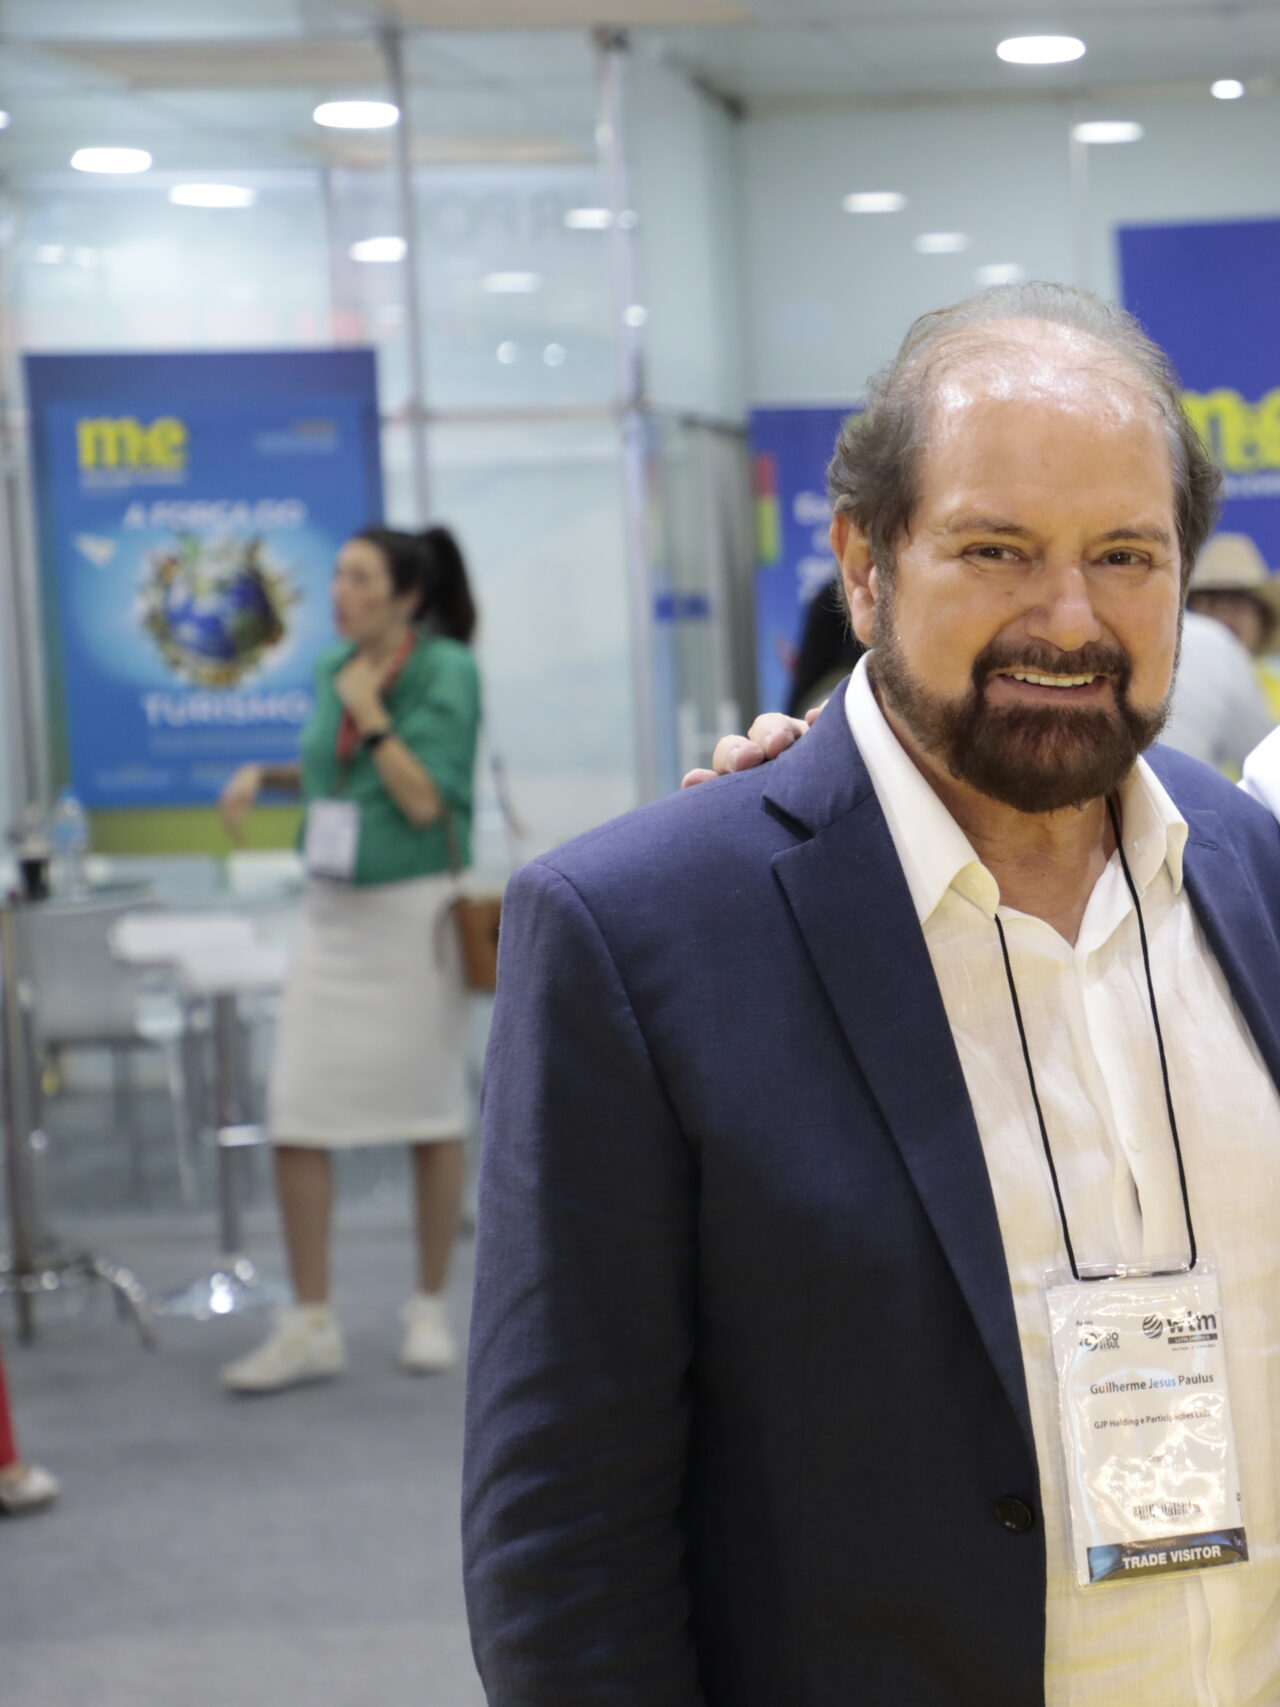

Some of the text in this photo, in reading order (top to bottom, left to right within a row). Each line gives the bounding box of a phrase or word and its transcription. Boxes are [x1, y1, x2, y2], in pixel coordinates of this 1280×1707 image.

[1166, 1310, 1217, 1334] wtm
[1090, 1372, 1214, 1395] Guilherme Jesus Paulus
[1094, 1420, 1108, 1430] GJP
[1109, 1417, 1139, 1427] Holding
[1122, 1545, 1221, 1570] TRADE VISITOR
